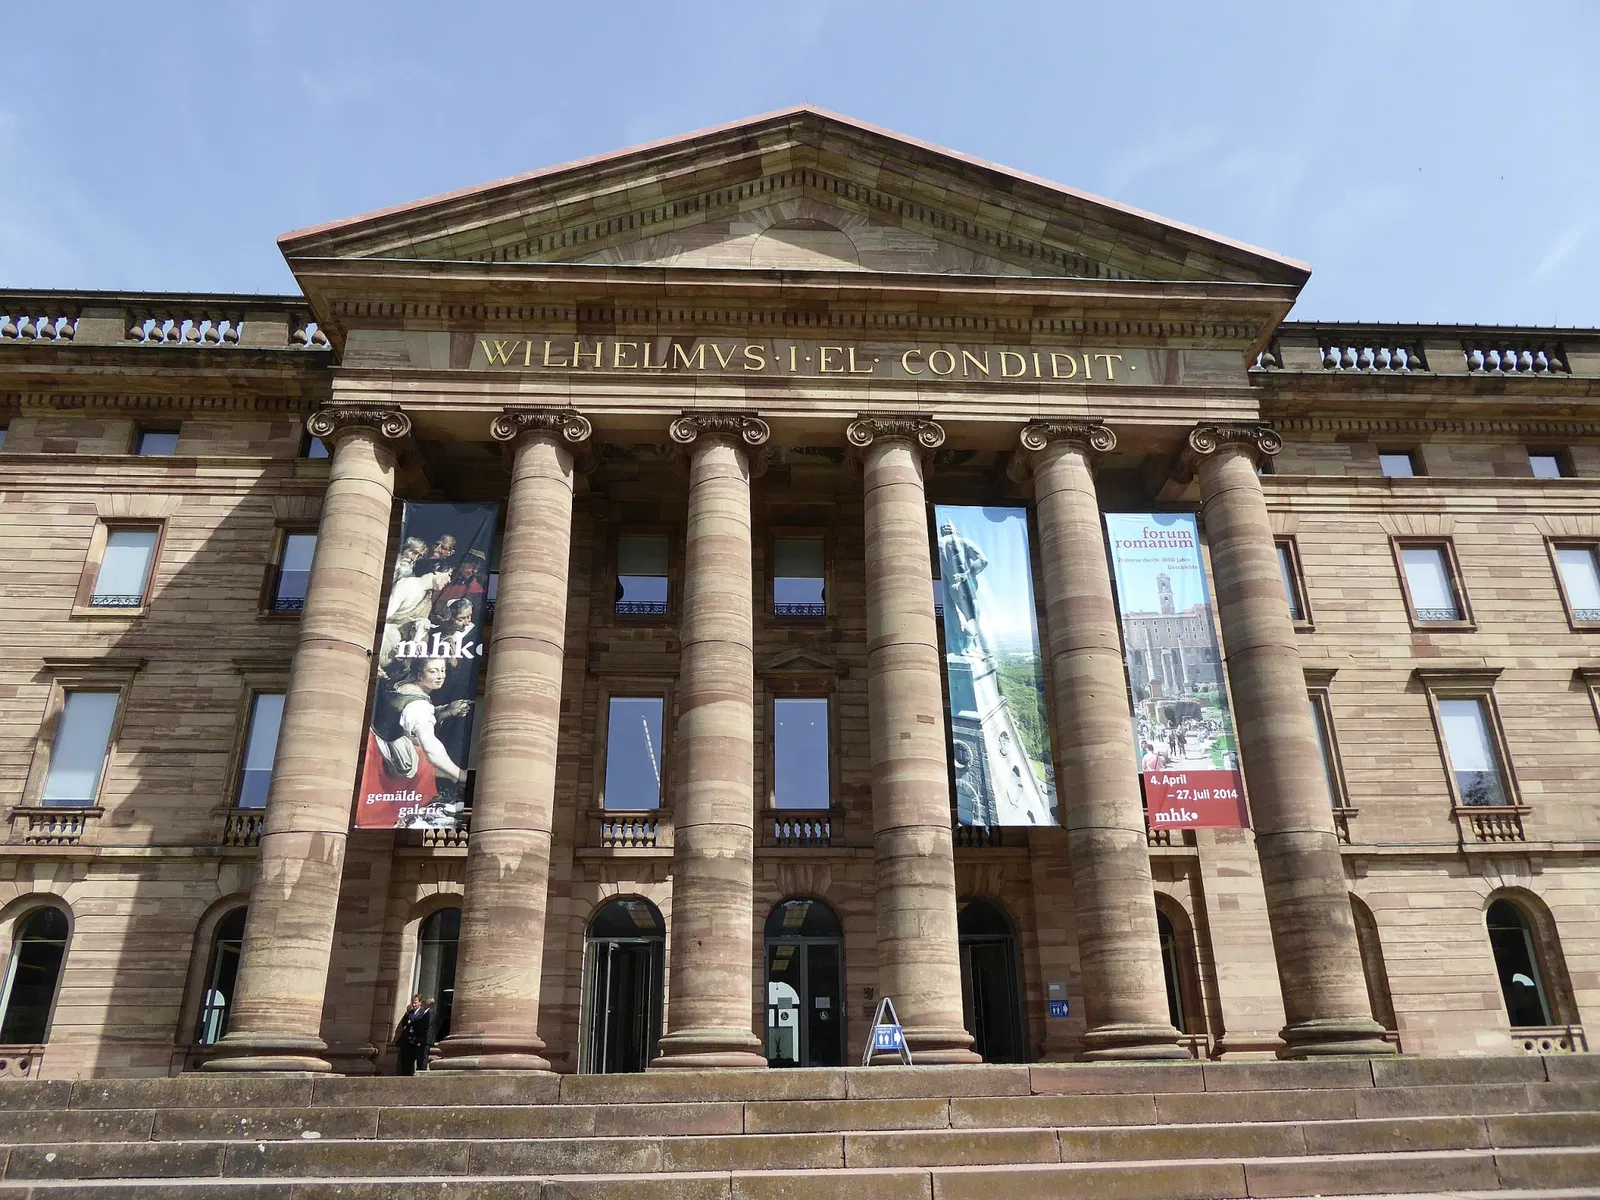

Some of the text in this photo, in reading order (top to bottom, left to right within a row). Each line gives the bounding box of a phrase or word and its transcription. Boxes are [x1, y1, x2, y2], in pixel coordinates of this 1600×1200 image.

[1143, 527, 1192, 539] forum
[1116, 539, 1194, 549] romanum
[1162, 774, 1187, 787] April
[366, 790, 423, 804] gemälde
[1176, 789, 1192, 800] 27.
[1193, 789, 1210, 801] Juli
[1213, 788, 1238, 799] 2014
[398, 804, 443, 817] galerie
